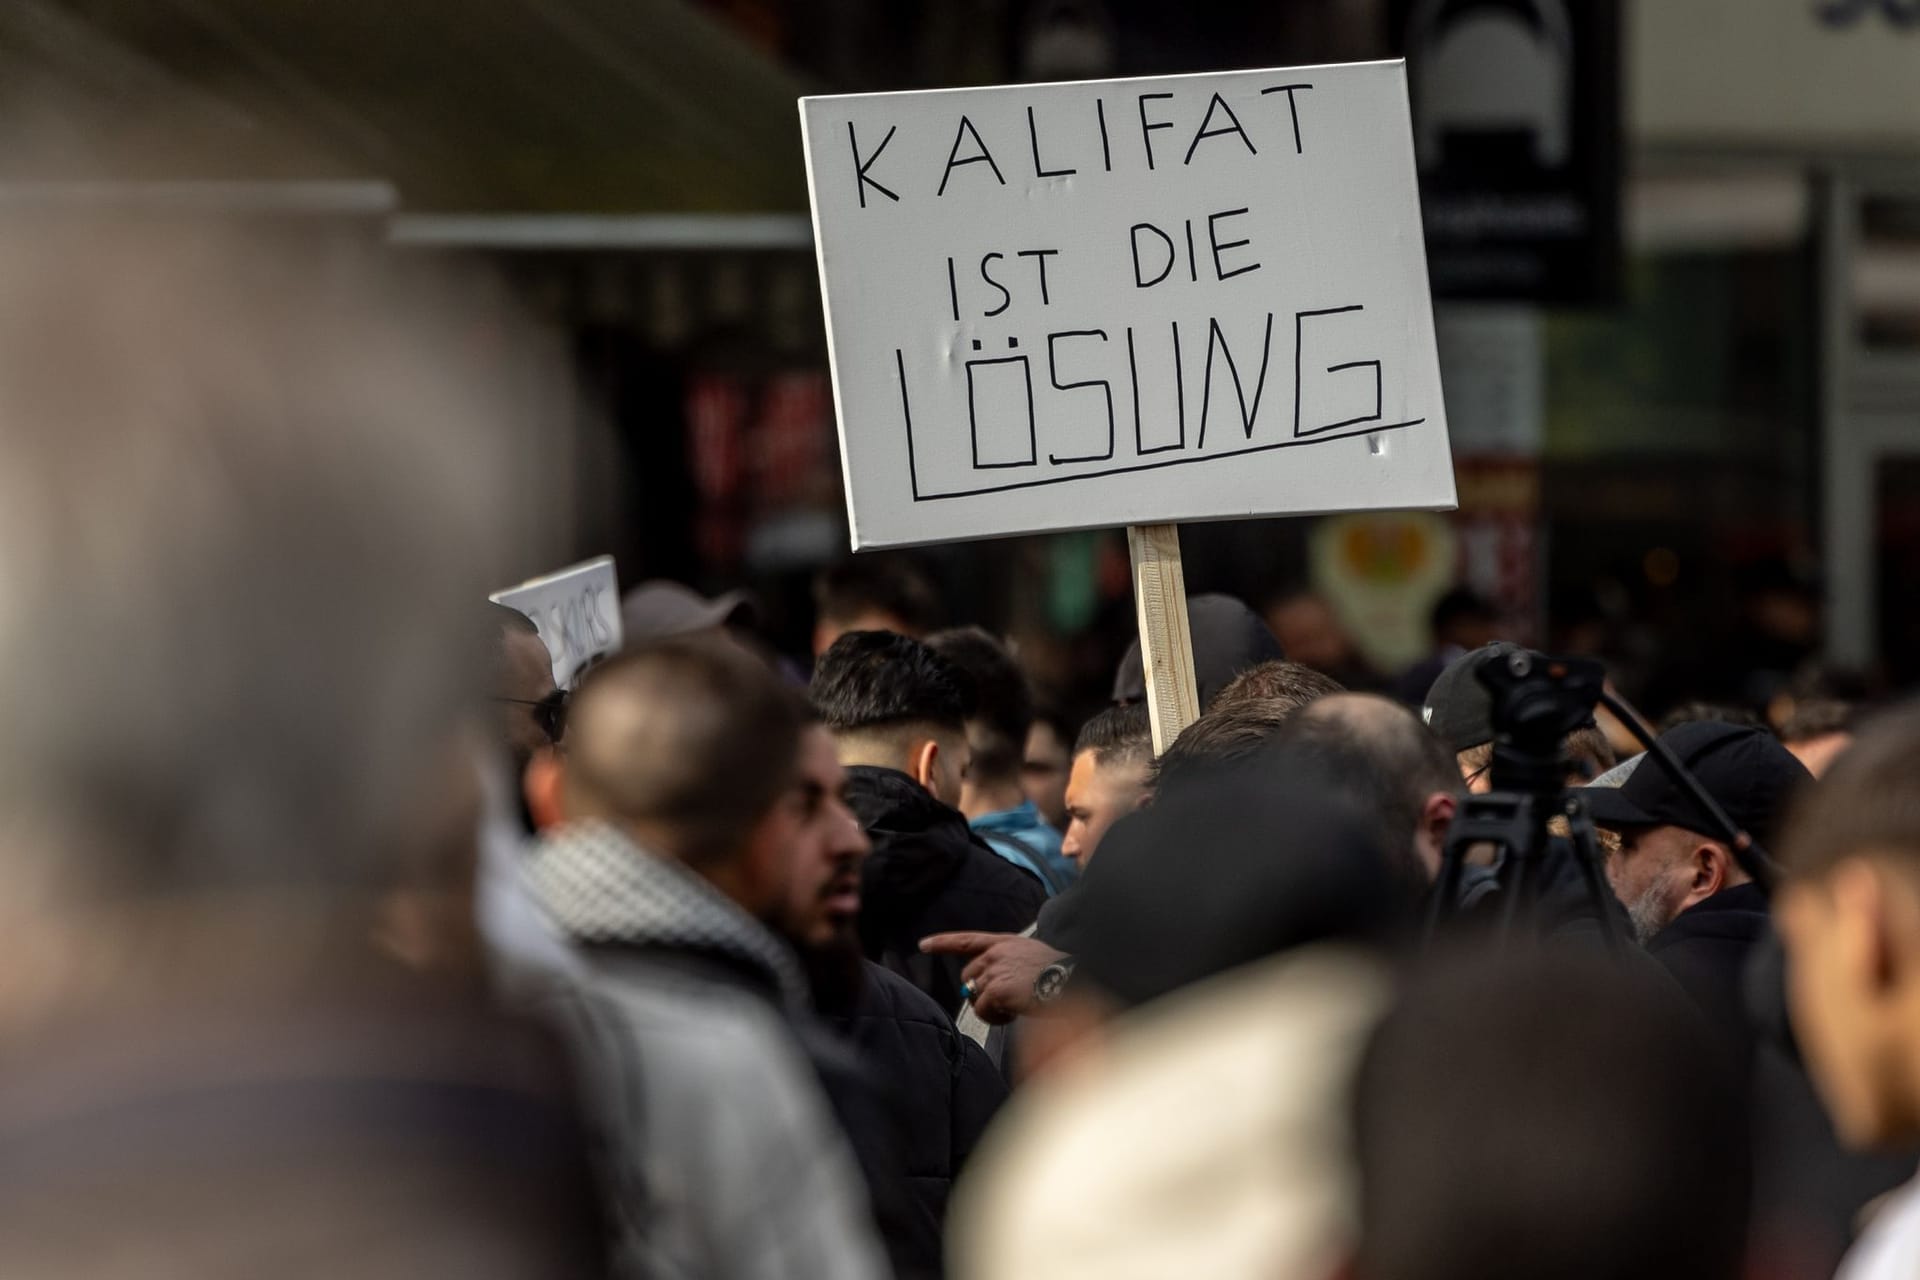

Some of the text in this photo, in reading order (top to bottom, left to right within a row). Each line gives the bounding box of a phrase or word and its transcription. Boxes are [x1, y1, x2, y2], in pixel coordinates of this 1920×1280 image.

[848, 84, 1314, 208] KALIFAT
[947, 208, 1262, 322] IST DIE
[897, 305, 1400, 502] LÖSUNG
